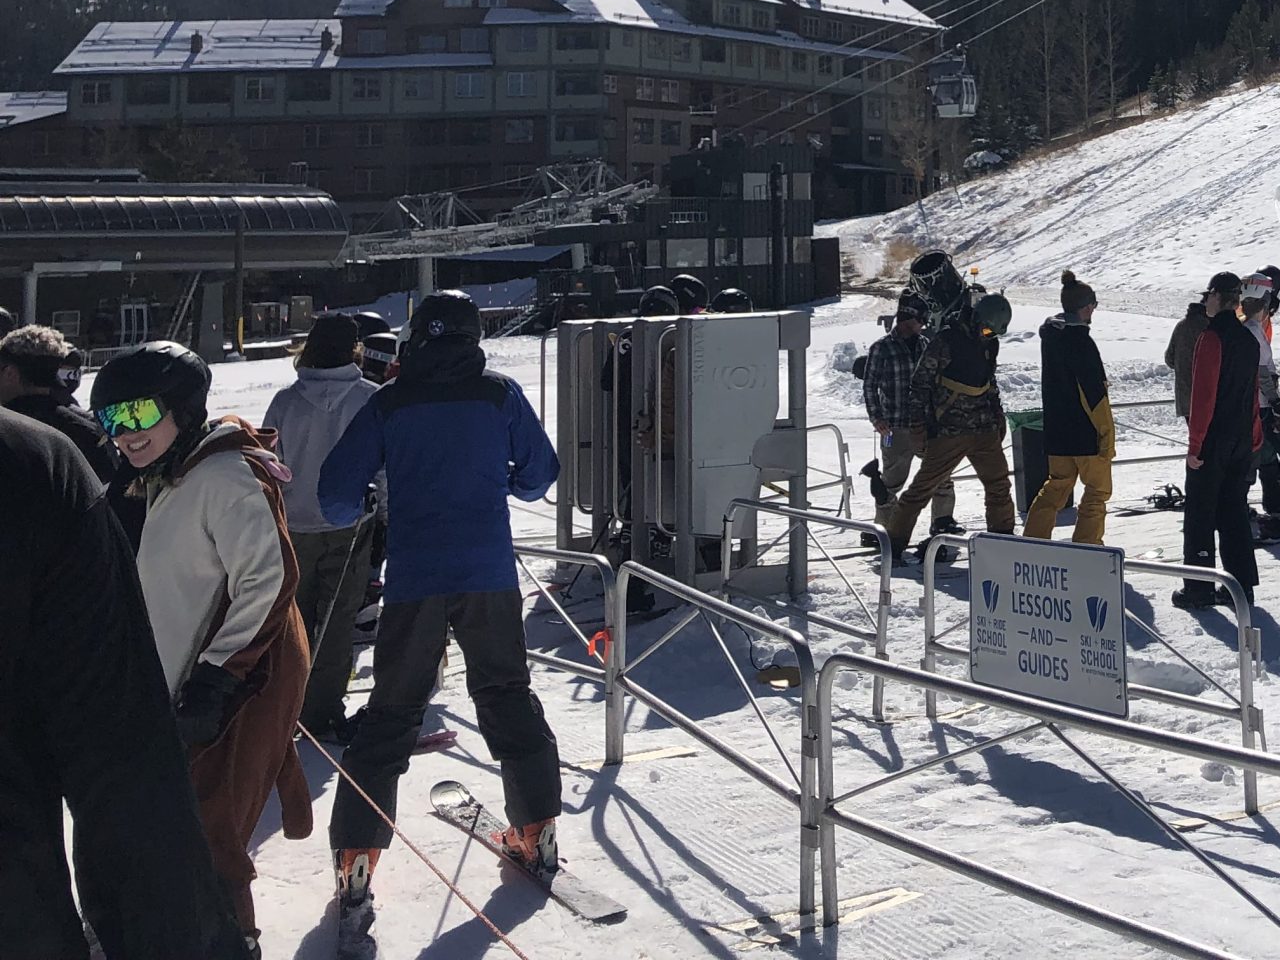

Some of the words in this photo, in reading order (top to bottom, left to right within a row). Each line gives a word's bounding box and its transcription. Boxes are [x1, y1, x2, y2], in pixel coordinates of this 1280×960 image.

[1014, 562, 1068, 592] PRIVATE
[1012, 591, 1072, 622] LESSONS
[976, 616, 986, 626] SKI
[993, 618, 1007, 631] RIDE
[976, 629, 1008, 649] SCHOOL
[1080, 635, 1091, 648] SKI
[1101, 639, 1117, 652] RIDE
[1018, 650, 1069, 682] GUIDES
[1080, 648, 1118, 671] SCHOOL
